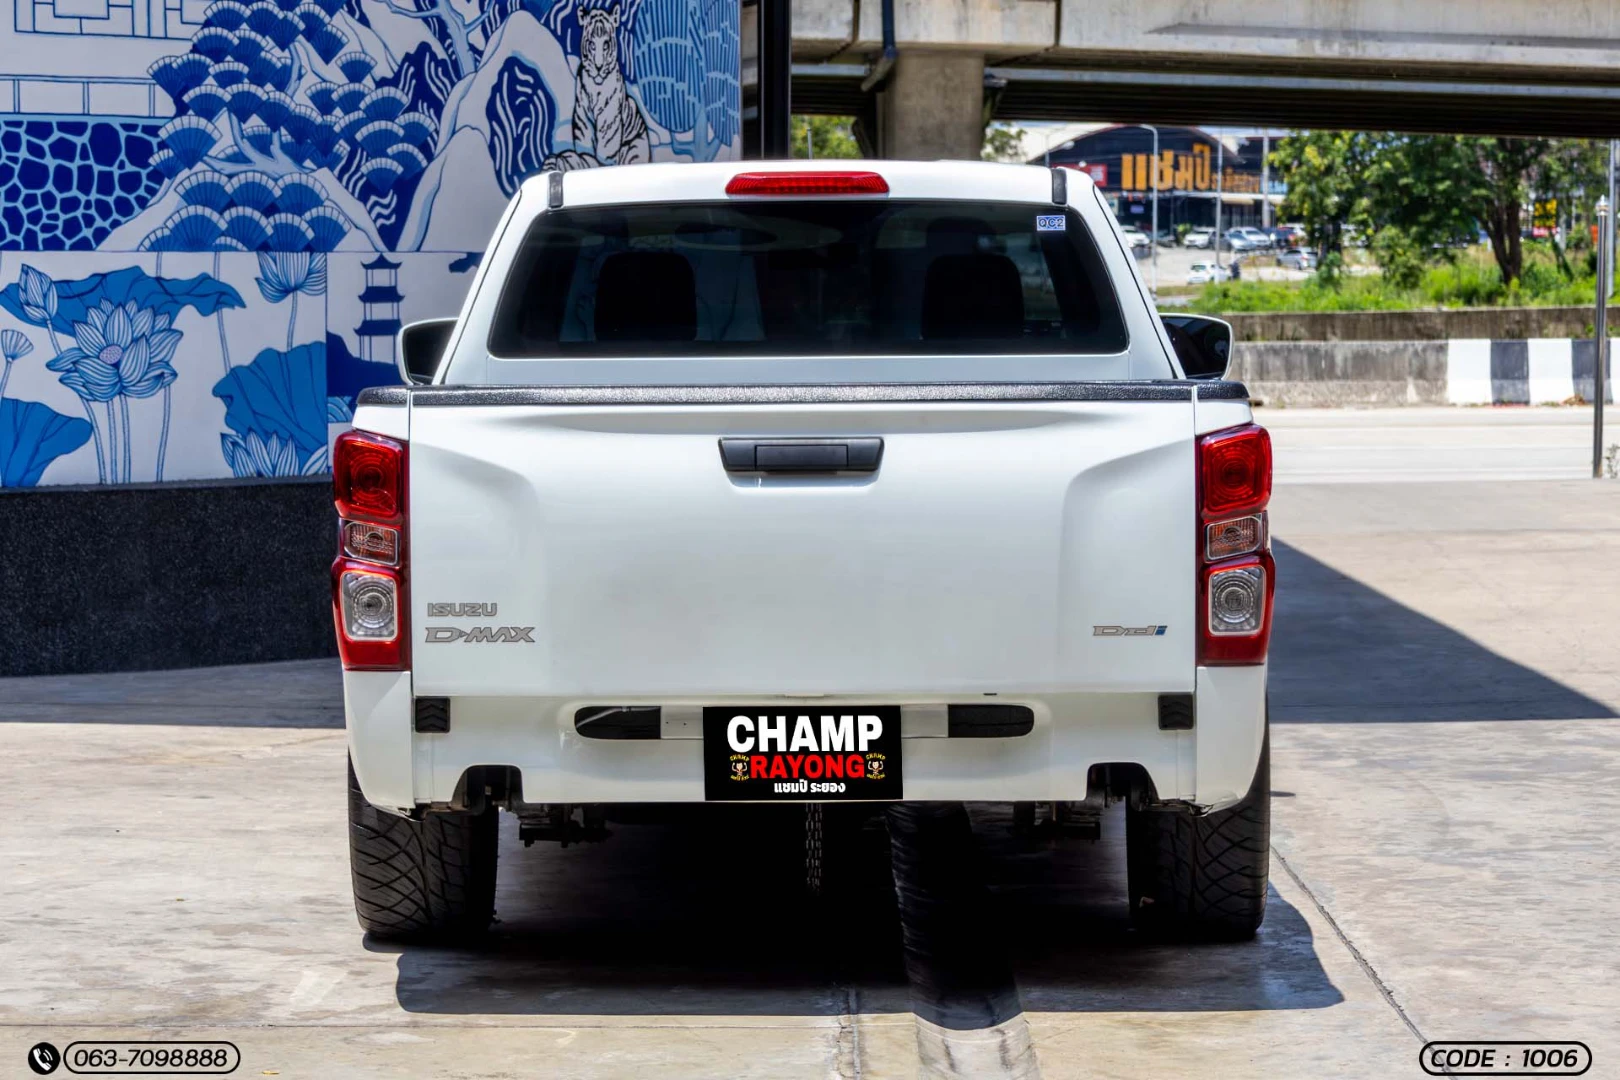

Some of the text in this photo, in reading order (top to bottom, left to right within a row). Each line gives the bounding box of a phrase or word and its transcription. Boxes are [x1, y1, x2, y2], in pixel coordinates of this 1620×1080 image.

[1038, 218, 1064, 228] QC2
[427, 602, 498, 617] ISUZU
[425, 626, 536, 643] D-MAX
[1092, 625, 1168, 636] Ddi
[726, 715, 883, 753] CHAMP
[750, 755, 865, 779] RAYONG
[810, 782, 846, 793] ระยอง
